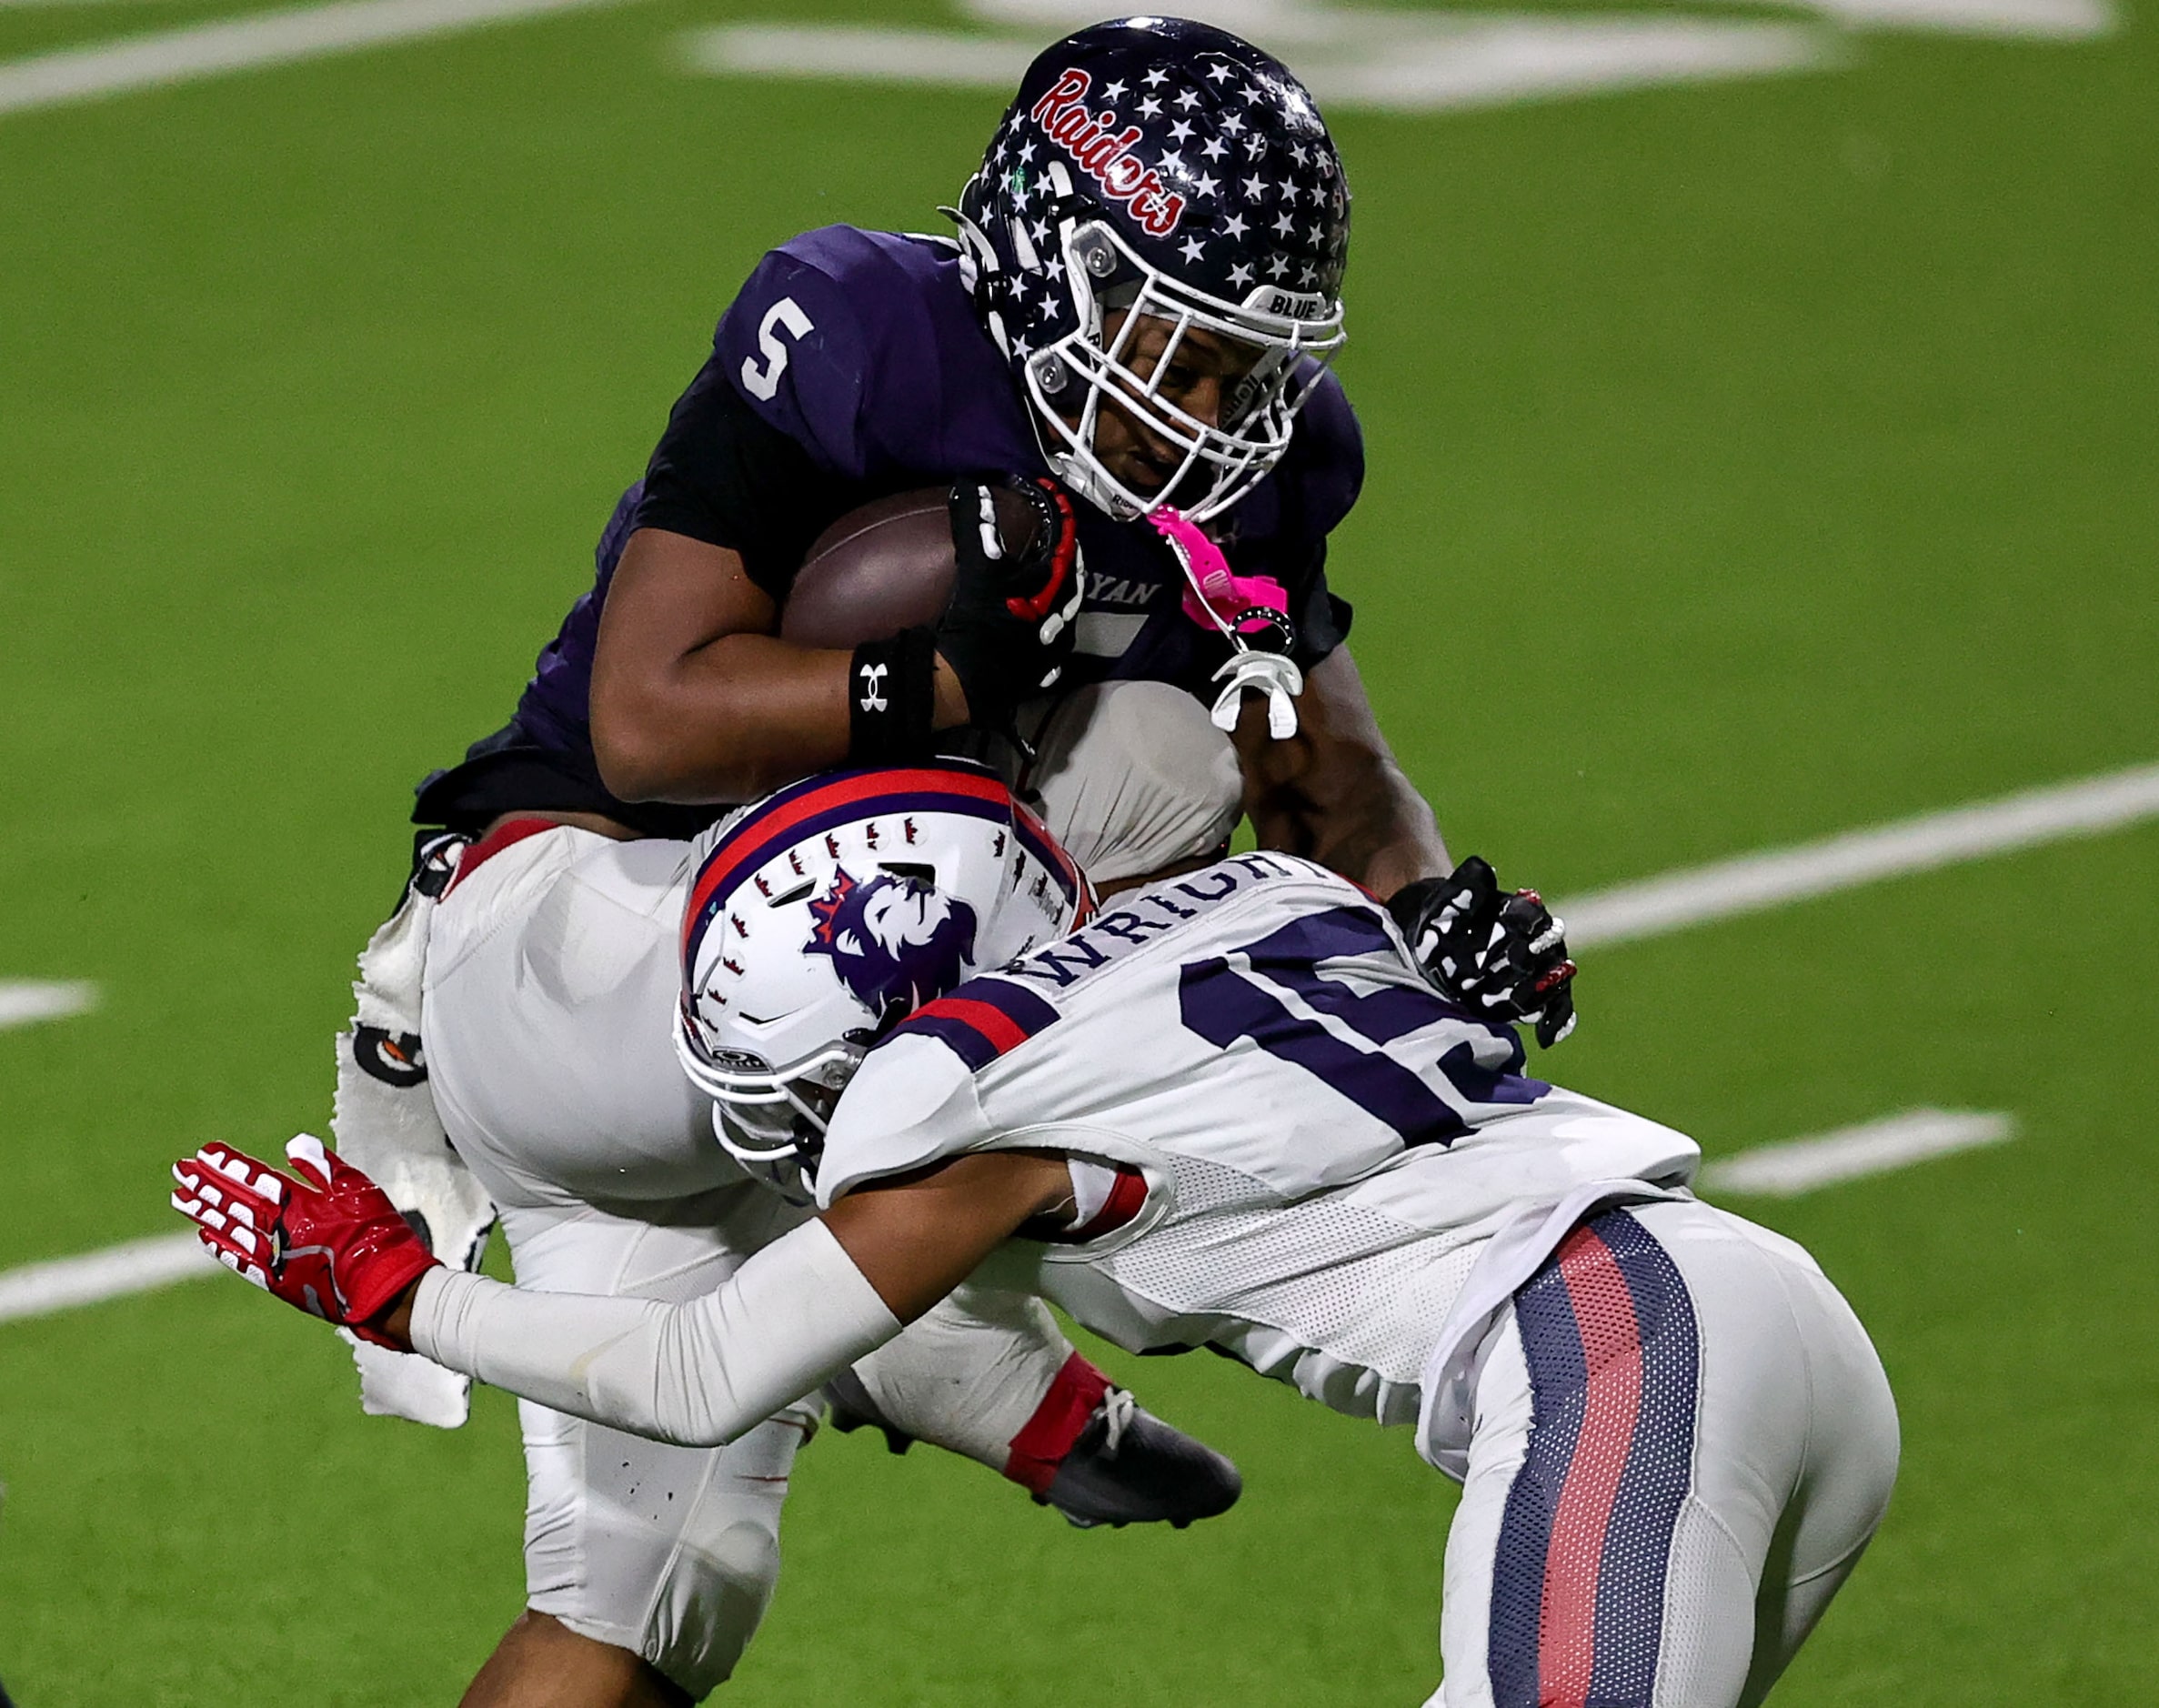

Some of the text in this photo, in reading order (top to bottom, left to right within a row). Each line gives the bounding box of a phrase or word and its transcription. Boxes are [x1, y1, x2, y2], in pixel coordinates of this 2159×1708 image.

[1031, 68, 1186, 237] Raiders
[740, 296, 815, 401] 5
[1269, 295, 1318, 318] BLUE
[1083, 570, 1162, 604] YAN
[1179, 906, 1552, 1148] 15
